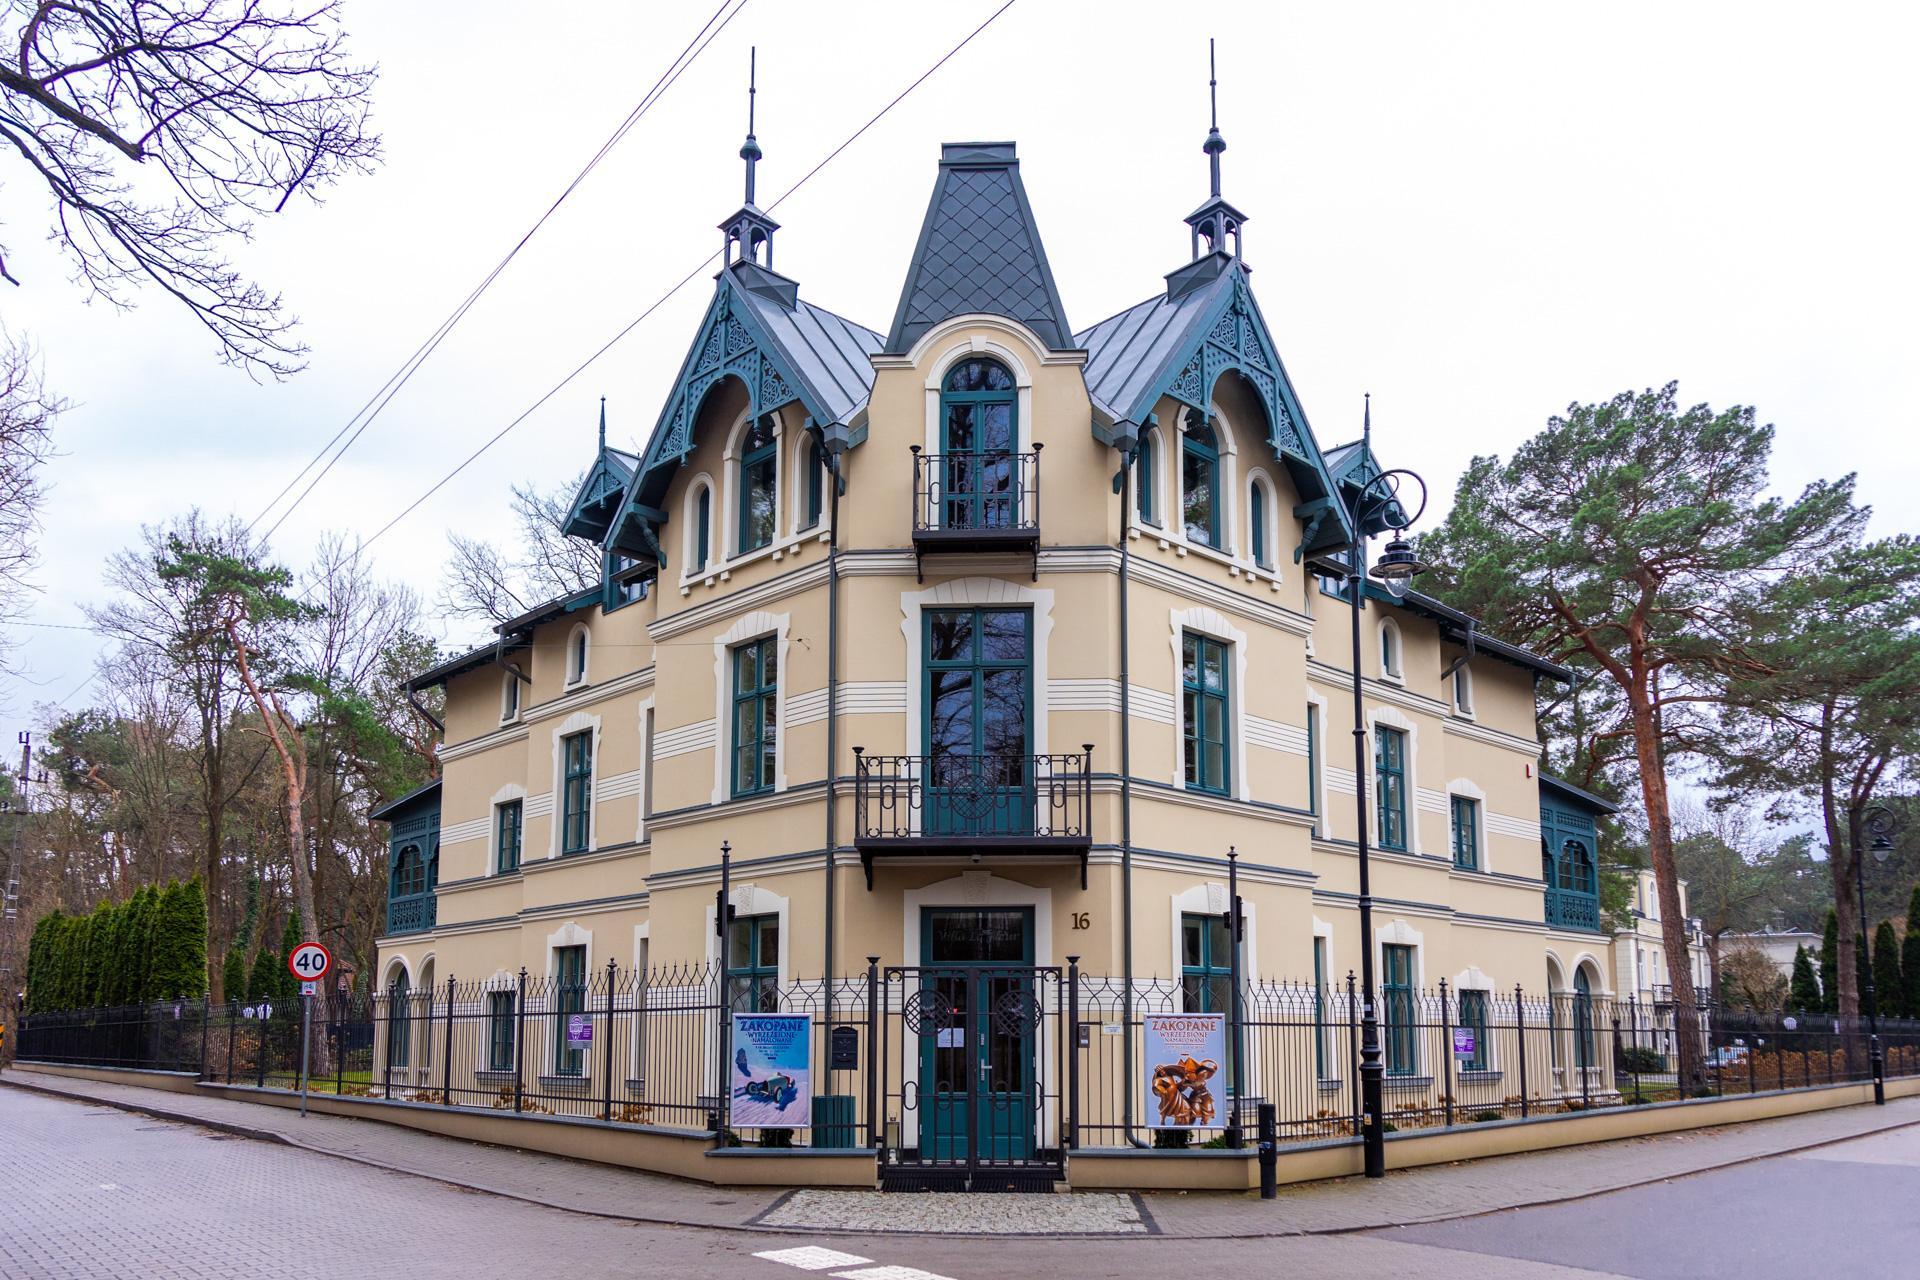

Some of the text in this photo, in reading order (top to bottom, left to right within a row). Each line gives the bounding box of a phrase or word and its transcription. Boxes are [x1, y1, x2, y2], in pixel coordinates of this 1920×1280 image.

[1071, 912, 1091, 930] 16
[296, 953, 325, 971] 40
[740, 1021, 803, 1031] ZAKOPANE
[1152, 1021, 1216, 1031] ZAKOPANE
